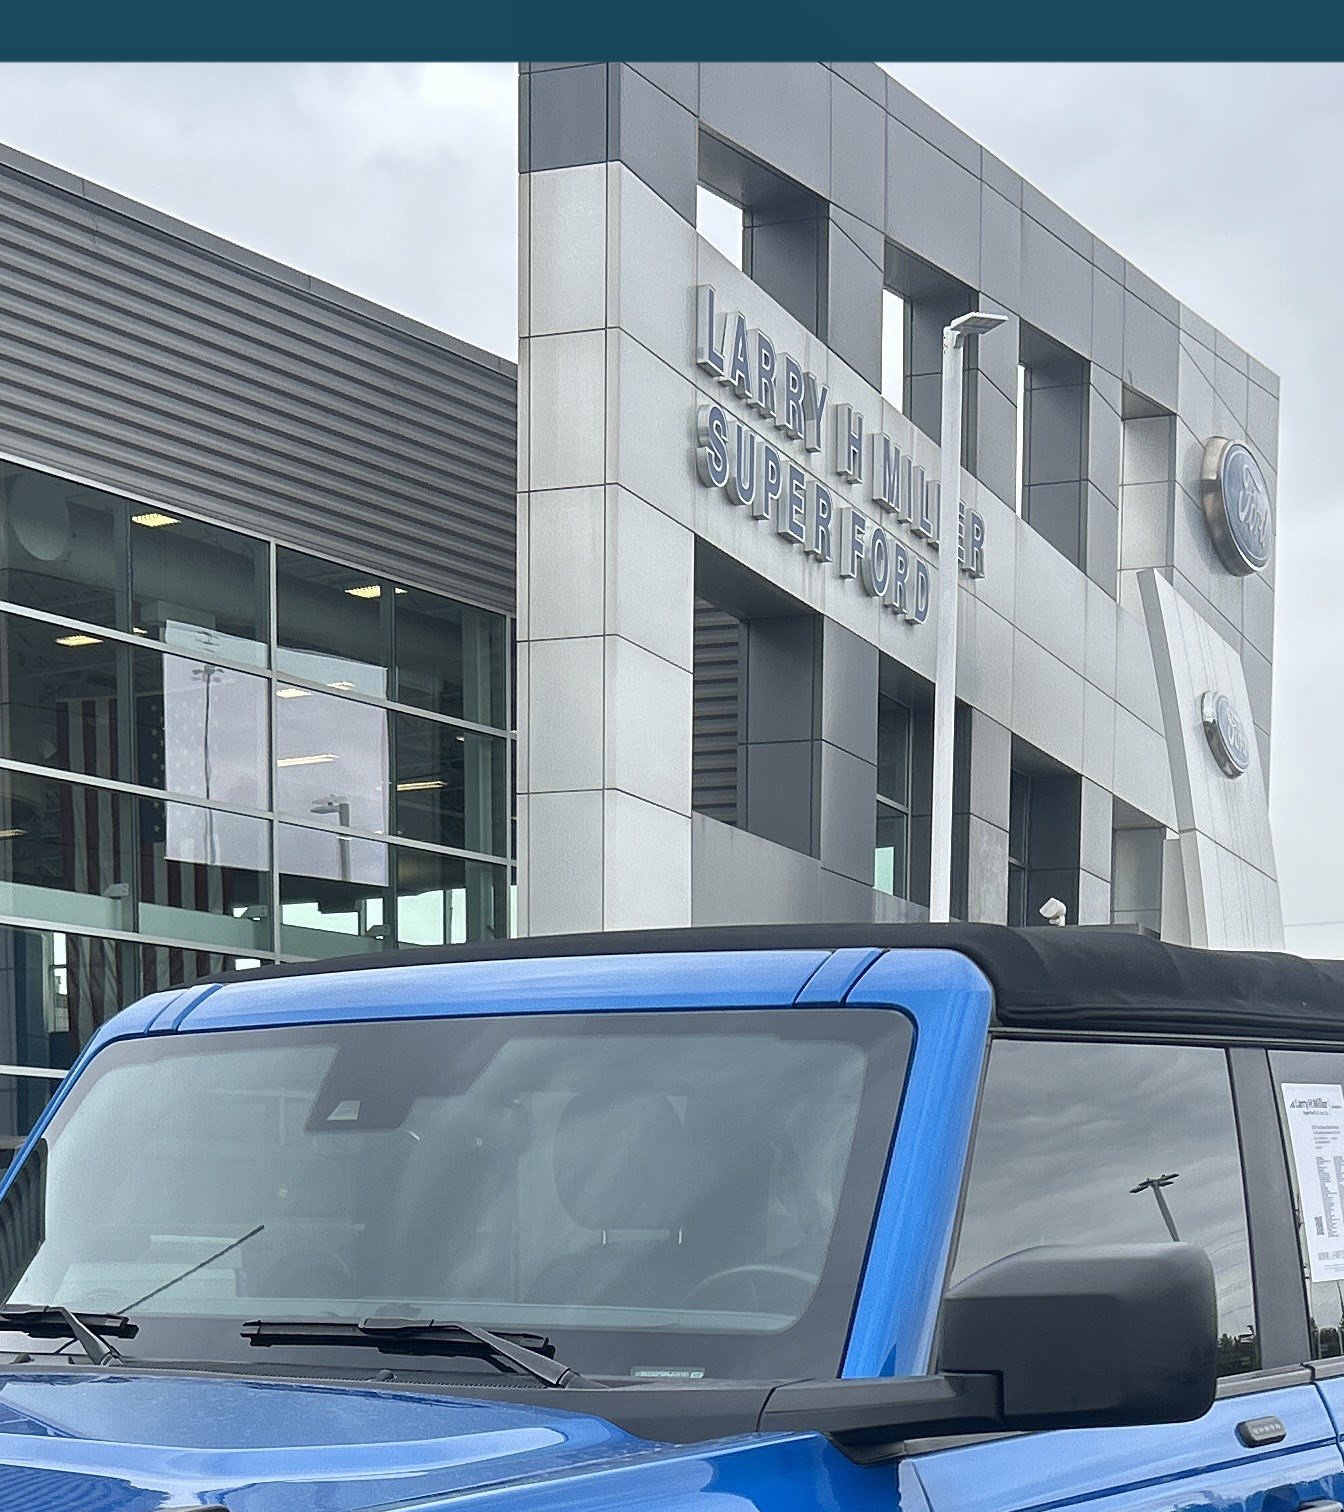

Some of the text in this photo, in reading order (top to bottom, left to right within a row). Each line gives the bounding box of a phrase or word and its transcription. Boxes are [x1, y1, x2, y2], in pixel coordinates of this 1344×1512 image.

[696, 284, 829, 452] LARRY
[836, 402, 863, 484] H
[697, 403, 929, 624] SUPER FORD
